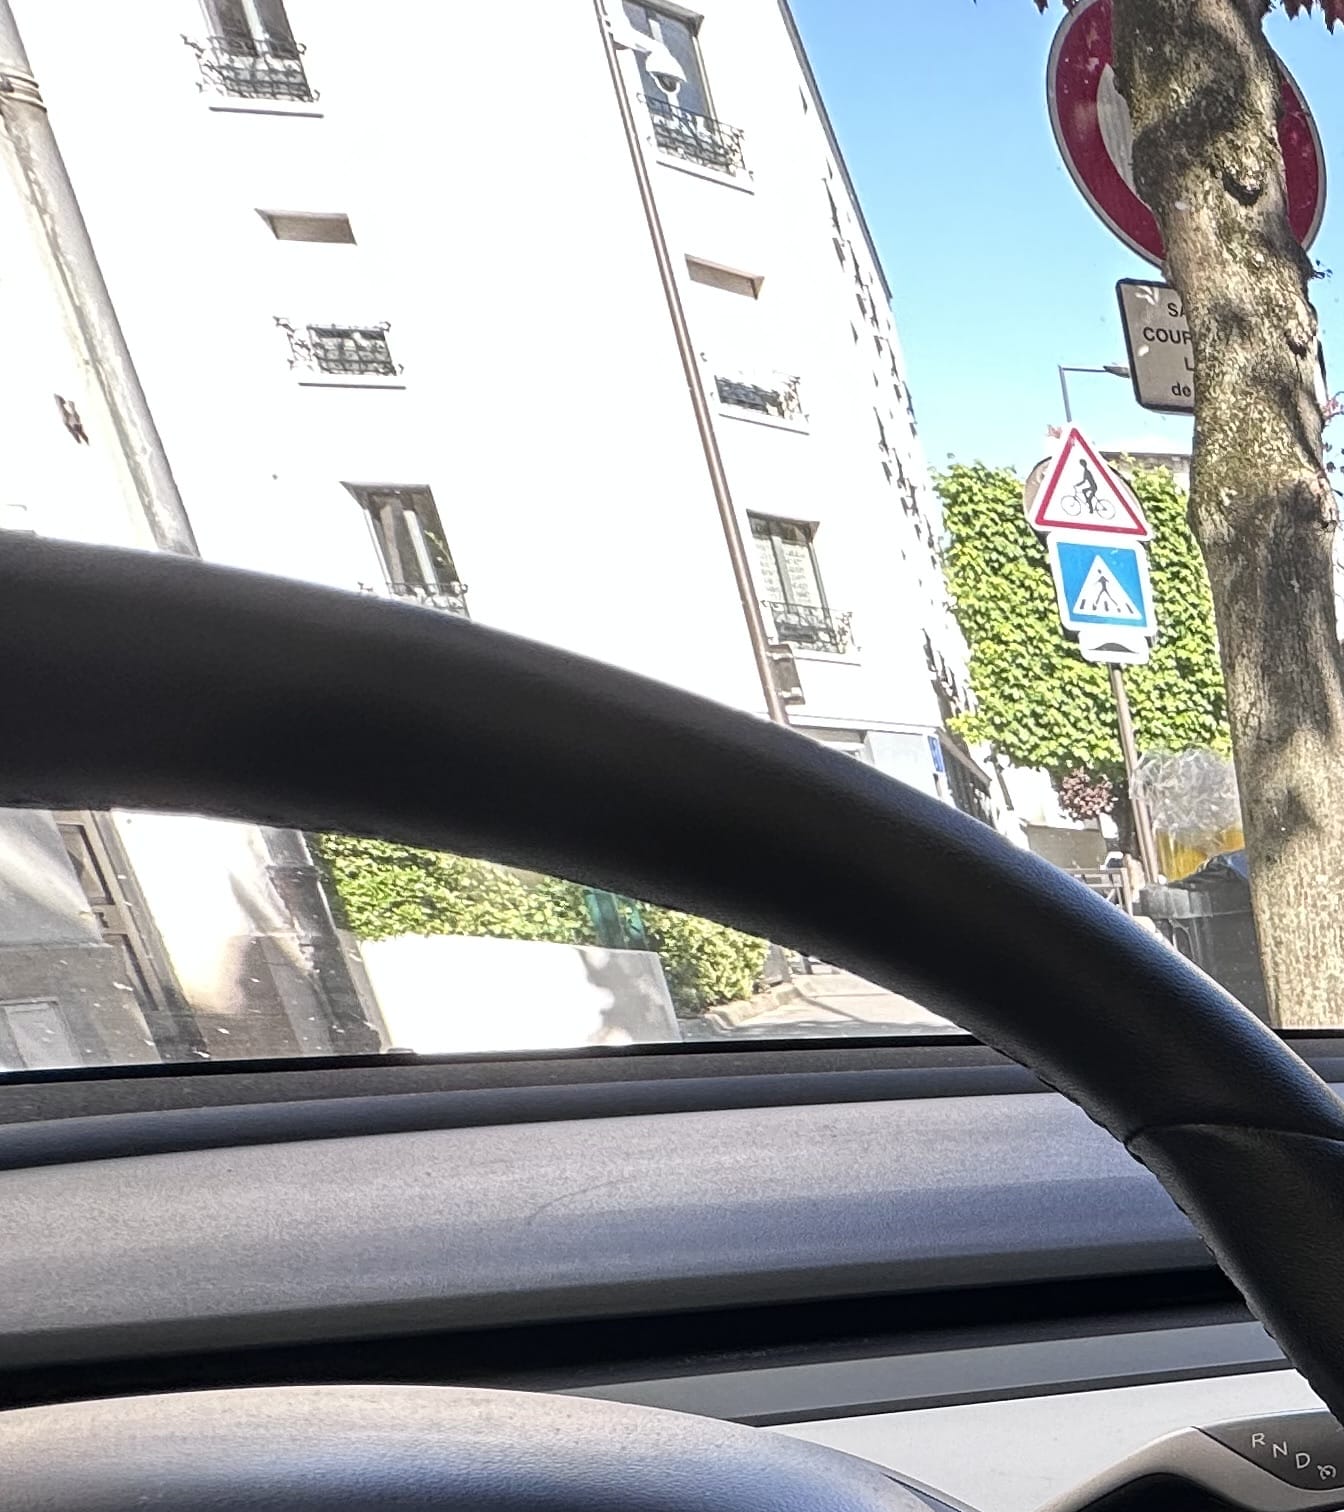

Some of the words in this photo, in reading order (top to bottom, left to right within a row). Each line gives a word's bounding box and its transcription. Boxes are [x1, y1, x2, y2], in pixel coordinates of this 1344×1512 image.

[1171, 381, 1192, 398] de
[1251, 1432, 1266, 1448] R
[1273, 1441, 1288, 1458] N
[1296, 1453, 1311, 1469] D
